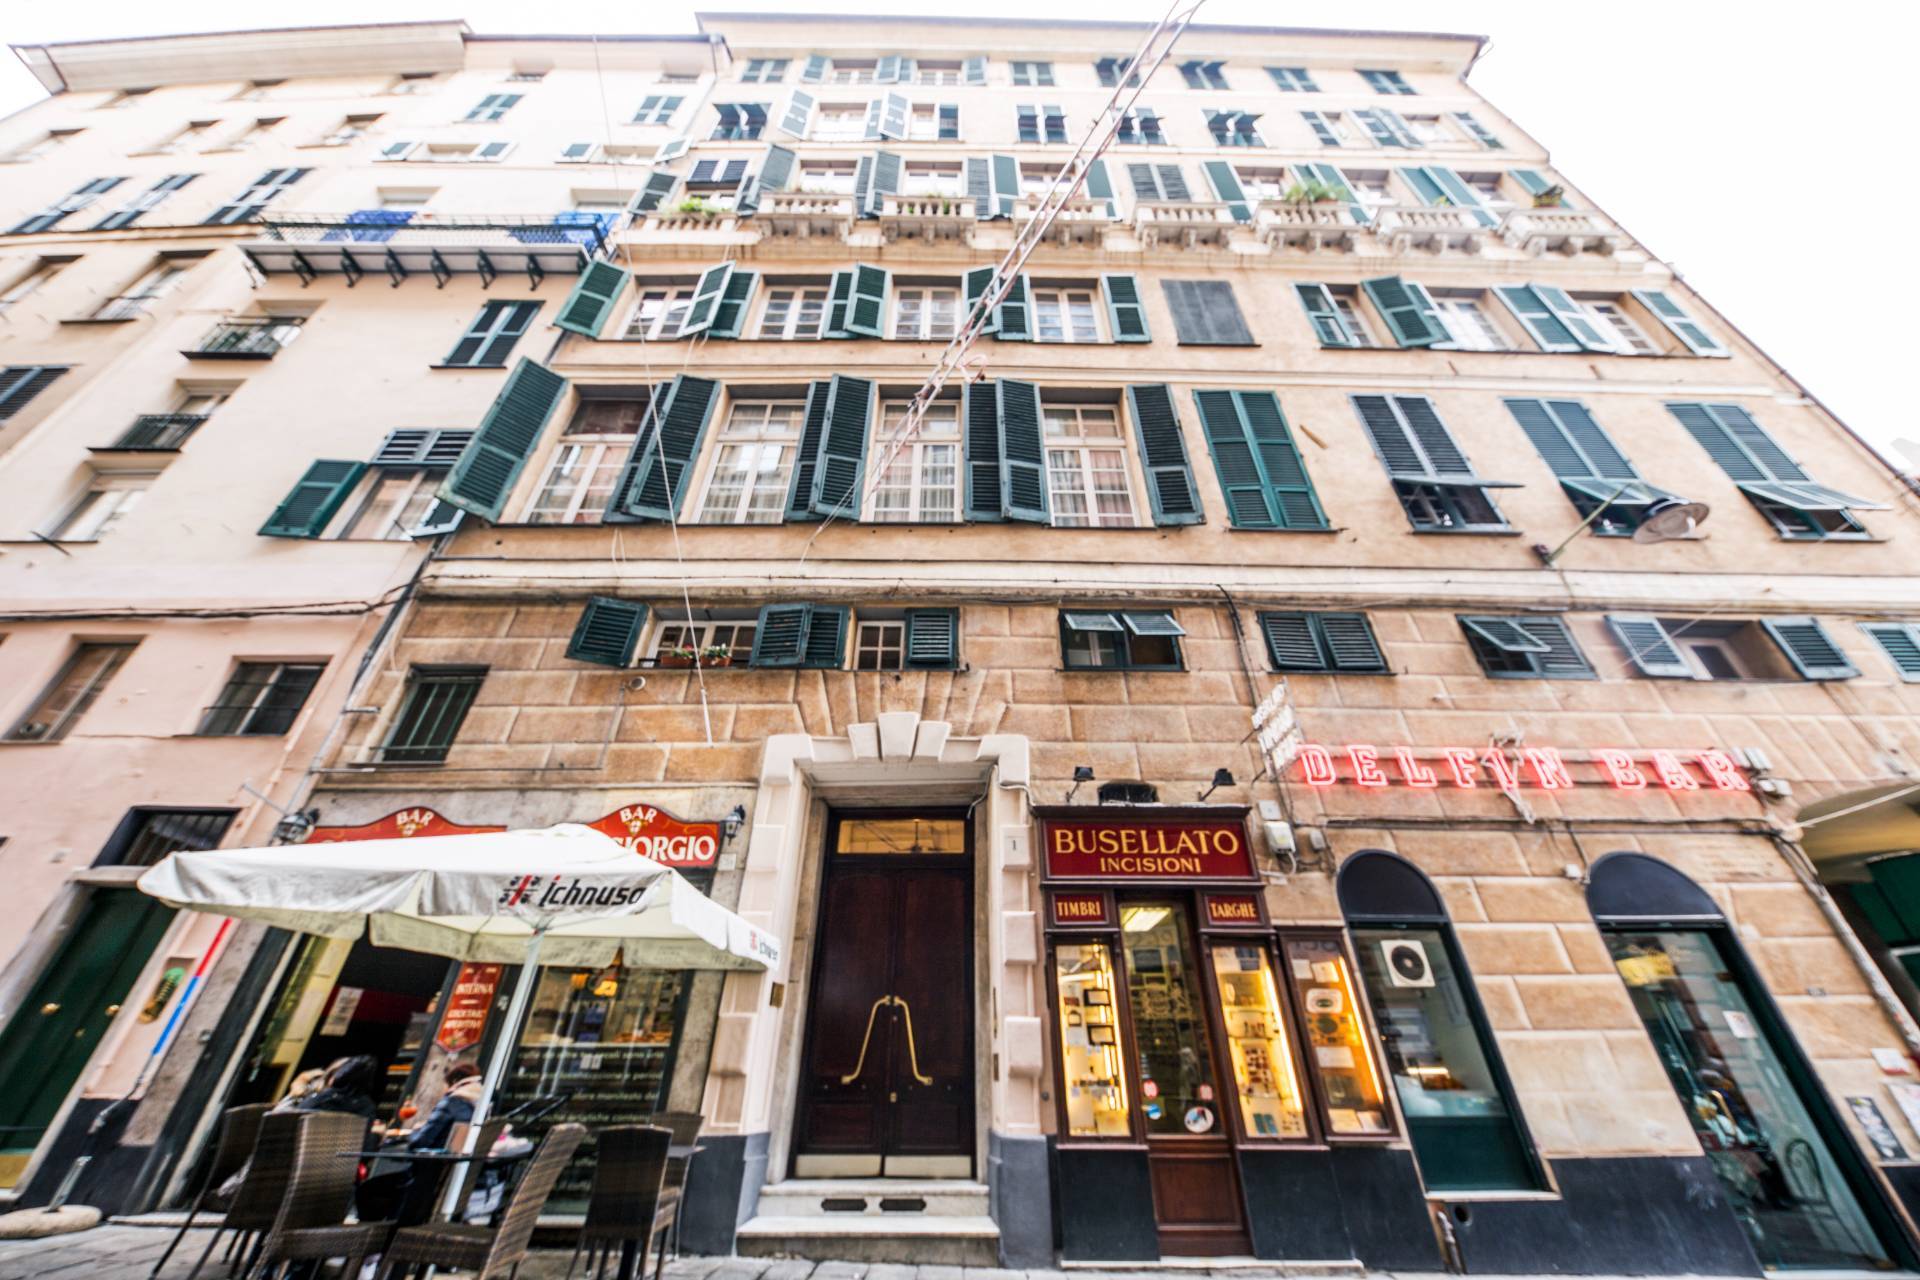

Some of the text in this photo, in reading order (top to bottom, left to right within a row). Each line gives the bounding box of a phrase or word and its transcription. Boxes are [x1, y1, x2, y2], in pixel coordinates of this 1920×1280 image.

[1592, 749, 1750, 790] BAR
[396, 808, 435, 826] BAR
[619, 806, 658, 823] BAR
[1054, 829, 1239, 855] BUSELLATO
[1100, 857, 1202, 873] INCISIONI
[1057, 901, 1101, 917] TIMBRI
[1210, 902, 1256, 918] TARGHE
